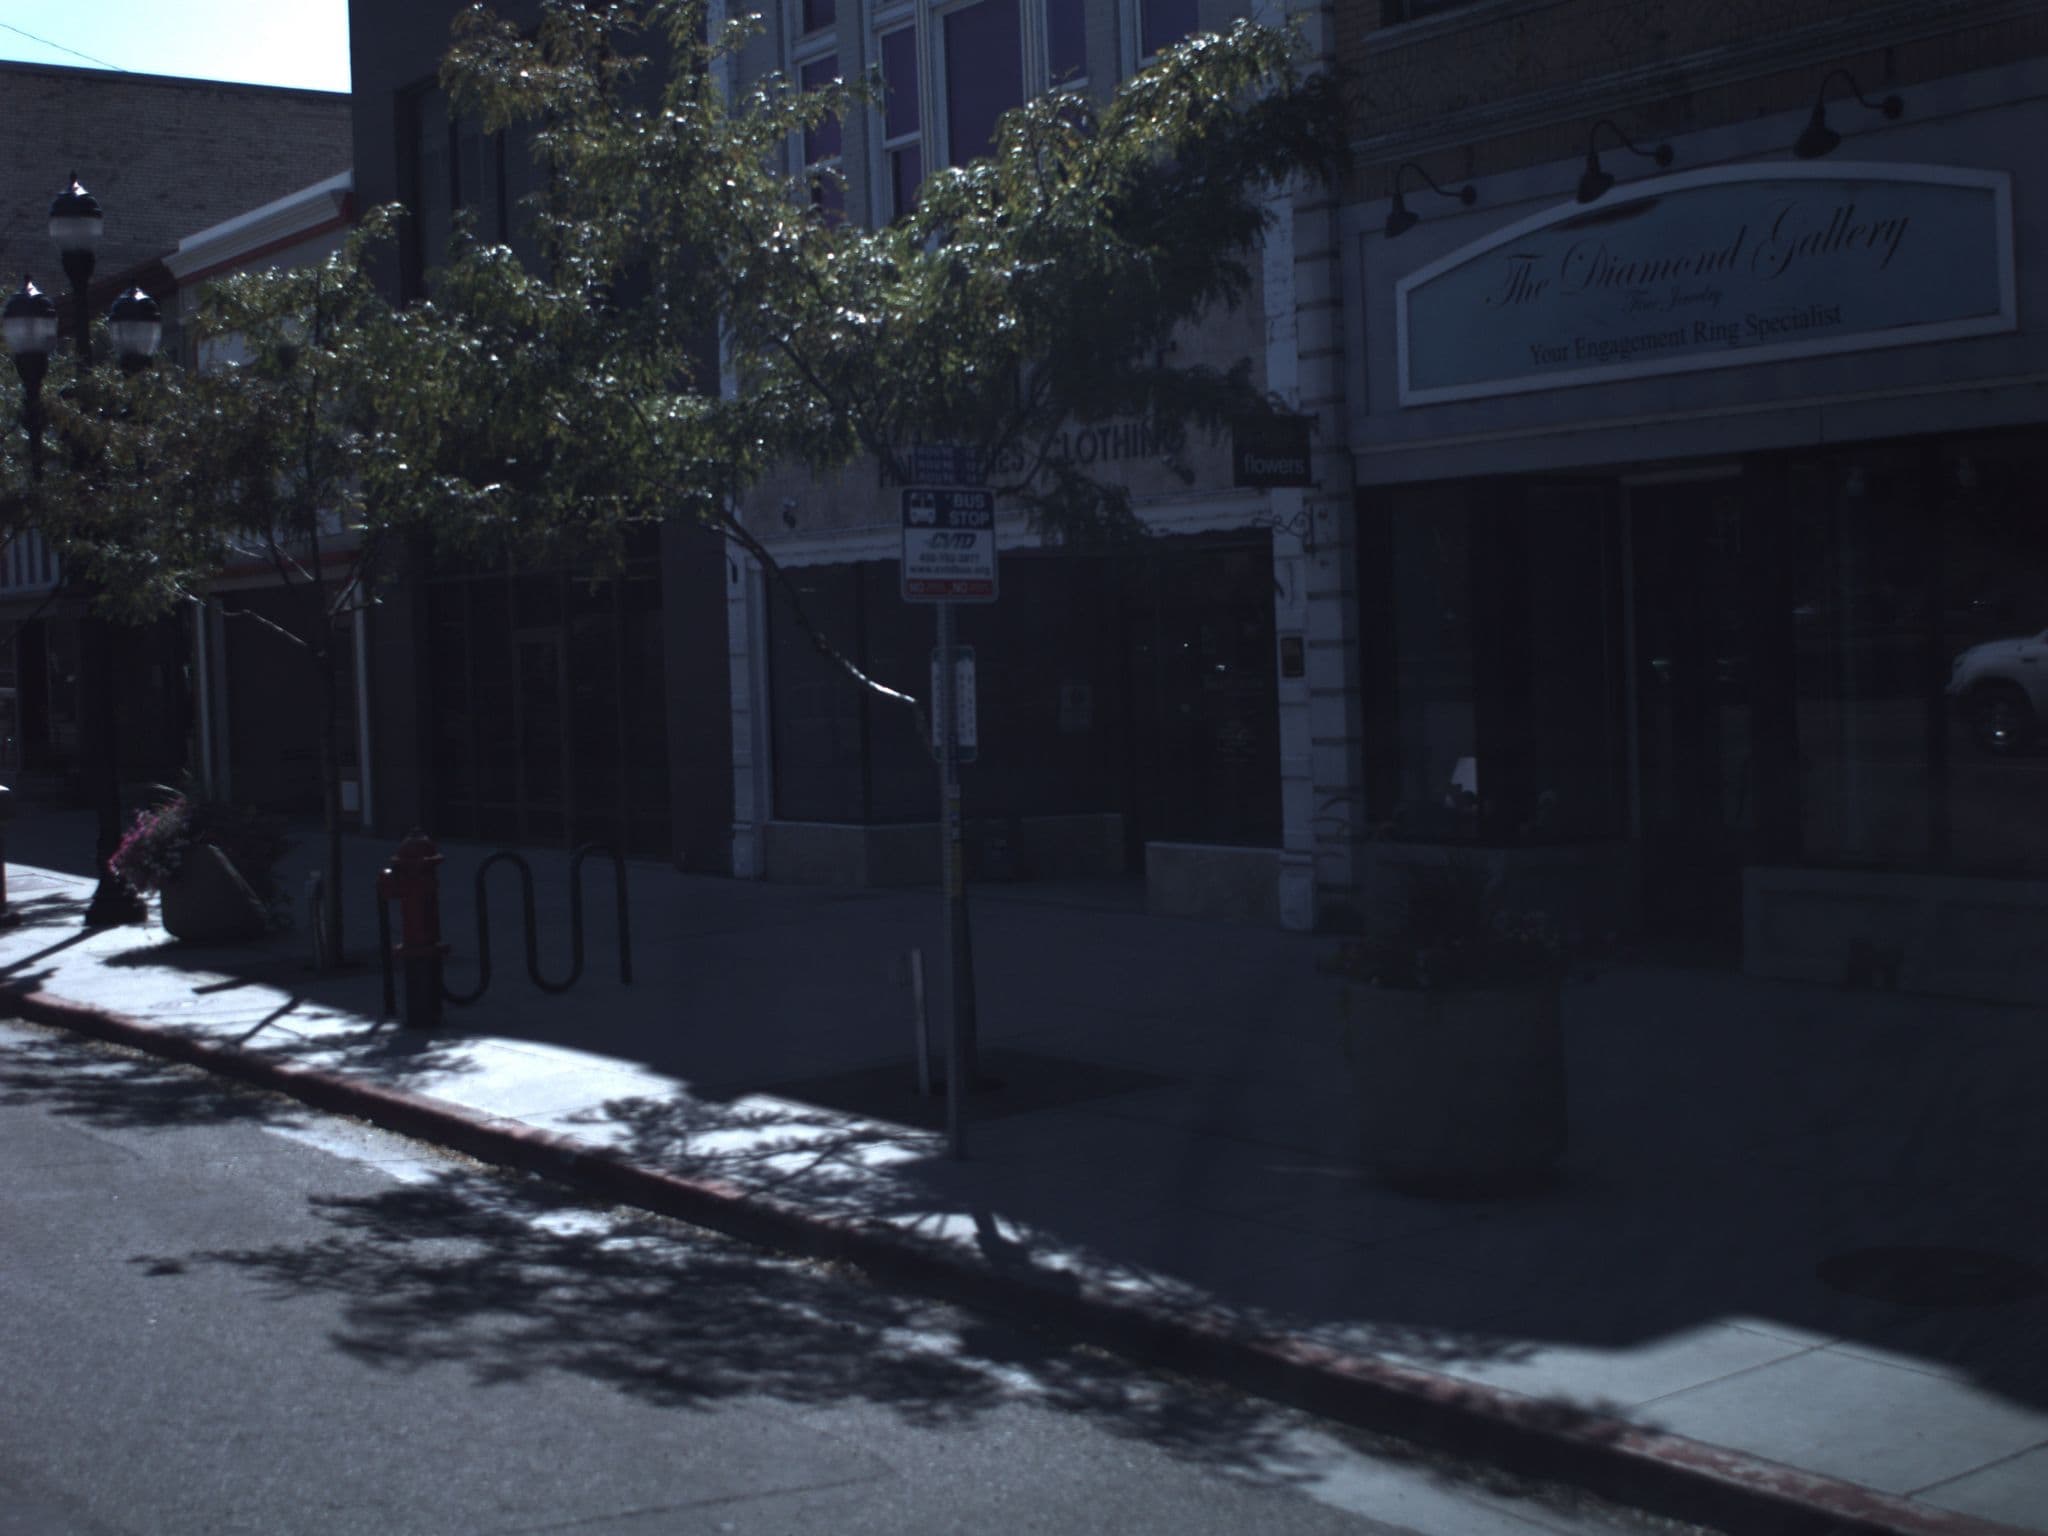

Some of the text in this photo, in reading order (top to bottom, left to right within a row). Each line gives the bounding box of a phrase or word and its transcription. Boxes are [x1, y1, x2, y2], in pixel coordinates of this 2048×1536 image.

[1486, 198, 1910, 307] The Diamond Gallery
[1529, 303, 1842, 366] Your Engagement Ring Specialist
[1047, 422, 1186, 464] LOTHING
[1244, 453, 1305, 475] flowers
[953, 493, 985, 508] BUS
[949, 510, 990, 526] STOP
